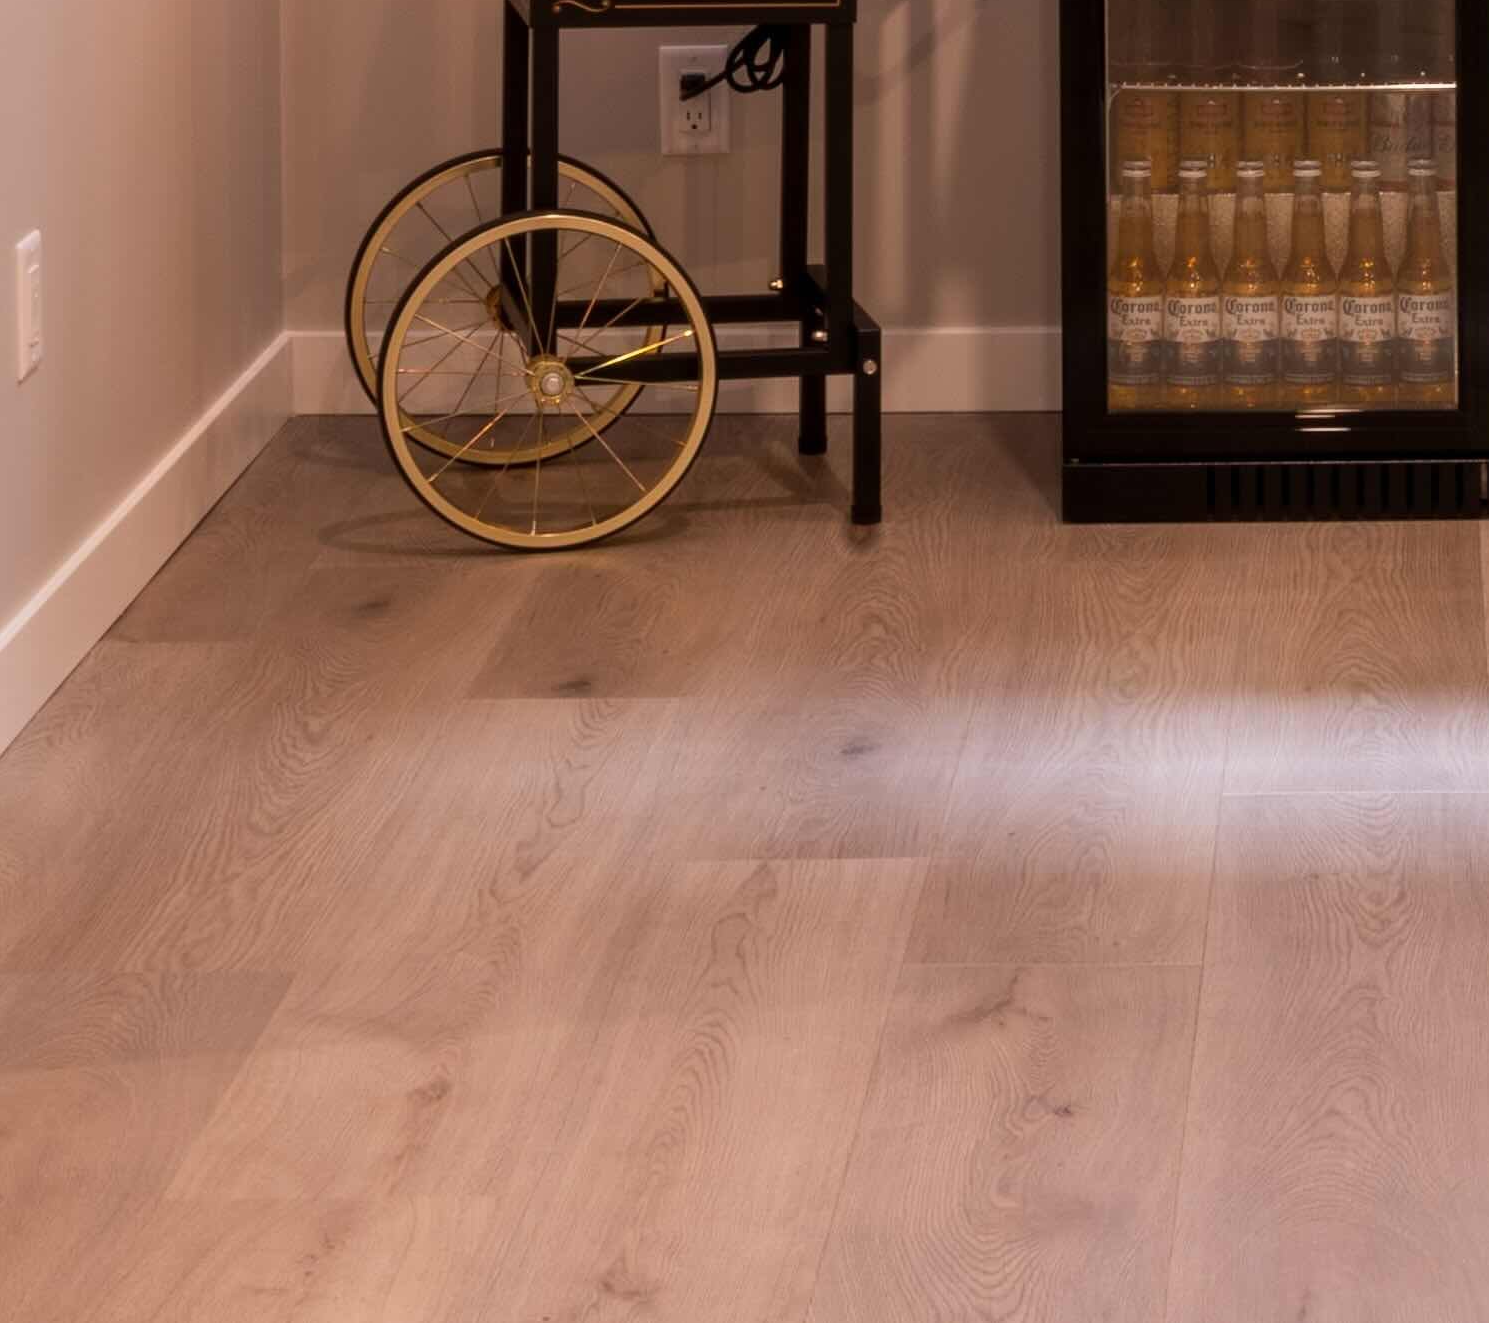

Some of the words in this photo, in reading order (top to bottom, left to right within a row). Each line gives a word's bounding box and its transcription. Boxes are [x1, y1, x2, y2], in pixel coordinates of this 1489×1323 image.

[1111, 298, 1160, 315] Corona
[1168, 299, 1216, 317] Corona
[1225, 297, 1274, 315] Corona
[1284, 297, 1335, 314] Corona
[1343, 298, 1391, 315] Corona
[1399, 296, 1448, 313] Corona
[1122, 314, 1151, 325] Extra
[1179, 315, 1208, 327] Extra
[1236, 314, 1266, 325] Extra
[1296, 314, 1325, 325] Extra
[1355, 314, 1383, 326] Extra
[1412, 312, 1440, 323] Extra
